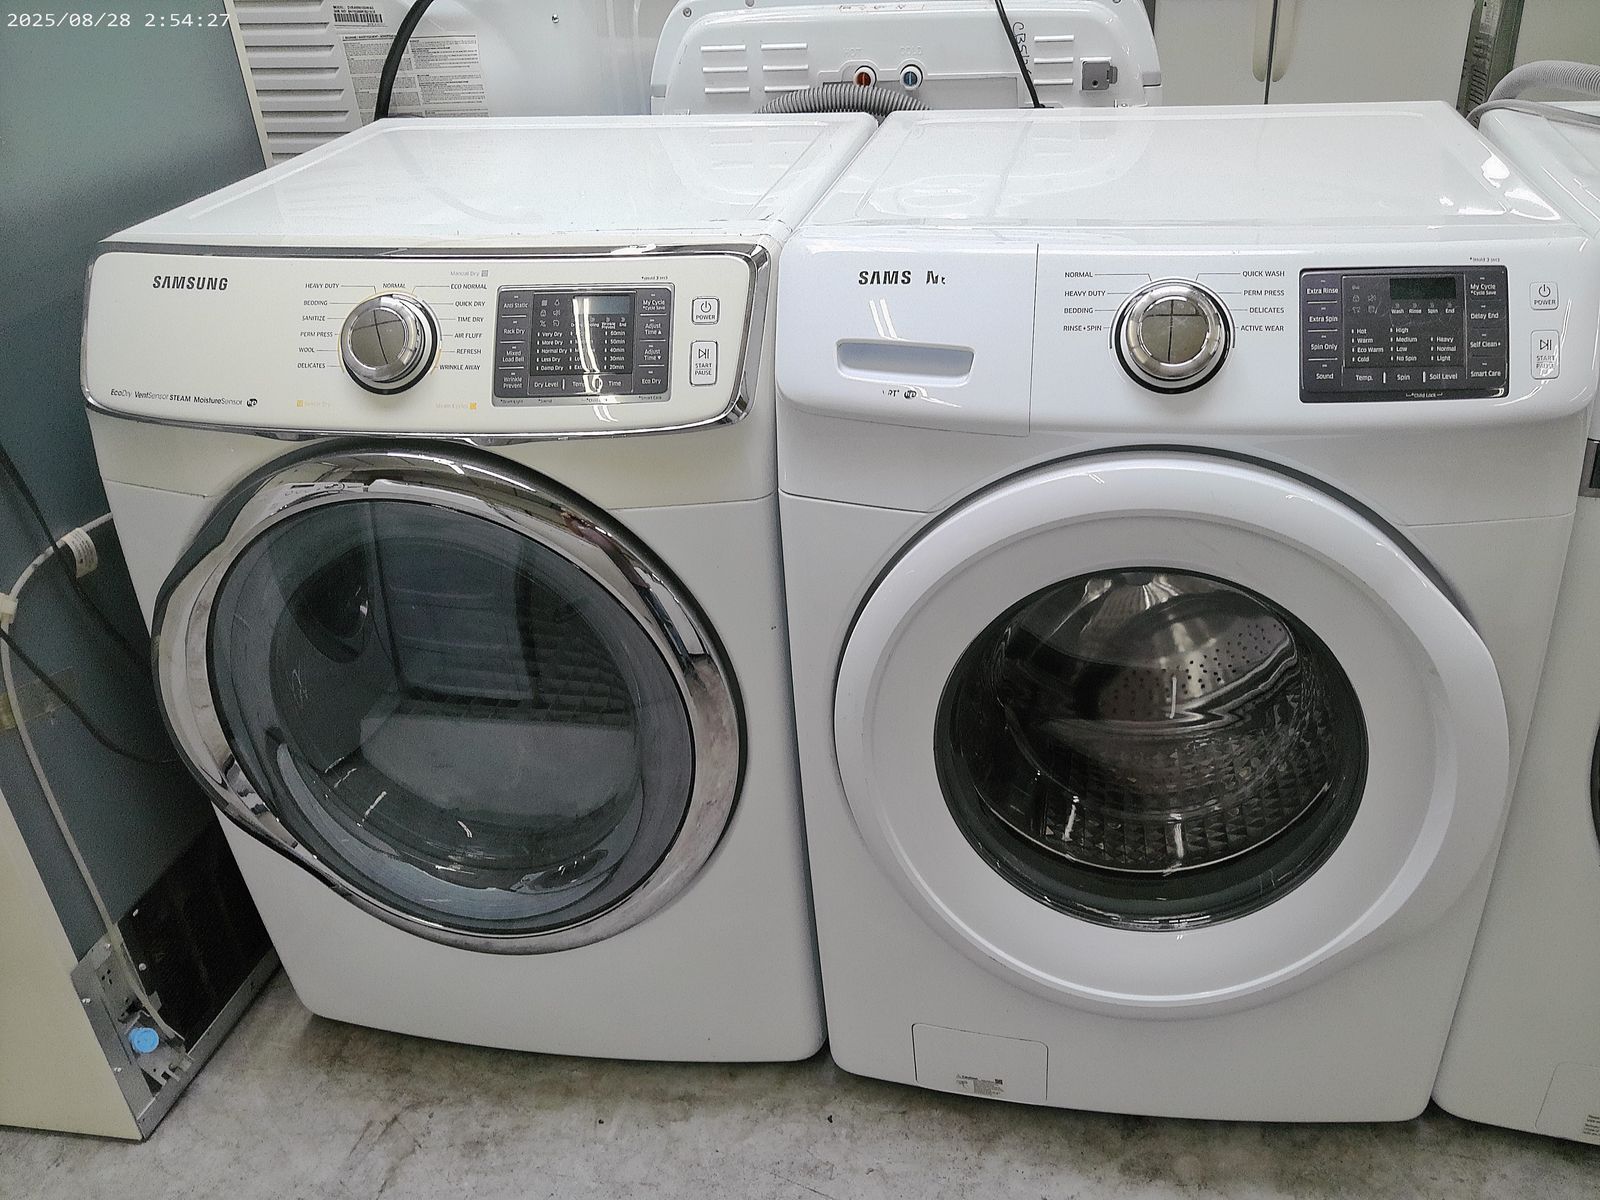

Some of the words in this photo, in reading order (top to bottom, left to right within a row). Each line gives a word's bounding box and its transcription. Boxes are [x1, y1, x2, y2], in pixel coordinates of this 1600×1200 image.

[1242, 270, 1264, 278] QUICK
[152, 275, 229, 291] SAMSUNG
[642, 299, 651, 307] My
[651, 299, 665, 307] Cycle
[1325, 315, 1338, 323] Spin
[1324, 343, 1338, 351] Only
[644, 348, 661, 356] Adjust
[169, 394, 191, 402] STEAM
[193, 396, 243, 405] MoistureSensor
